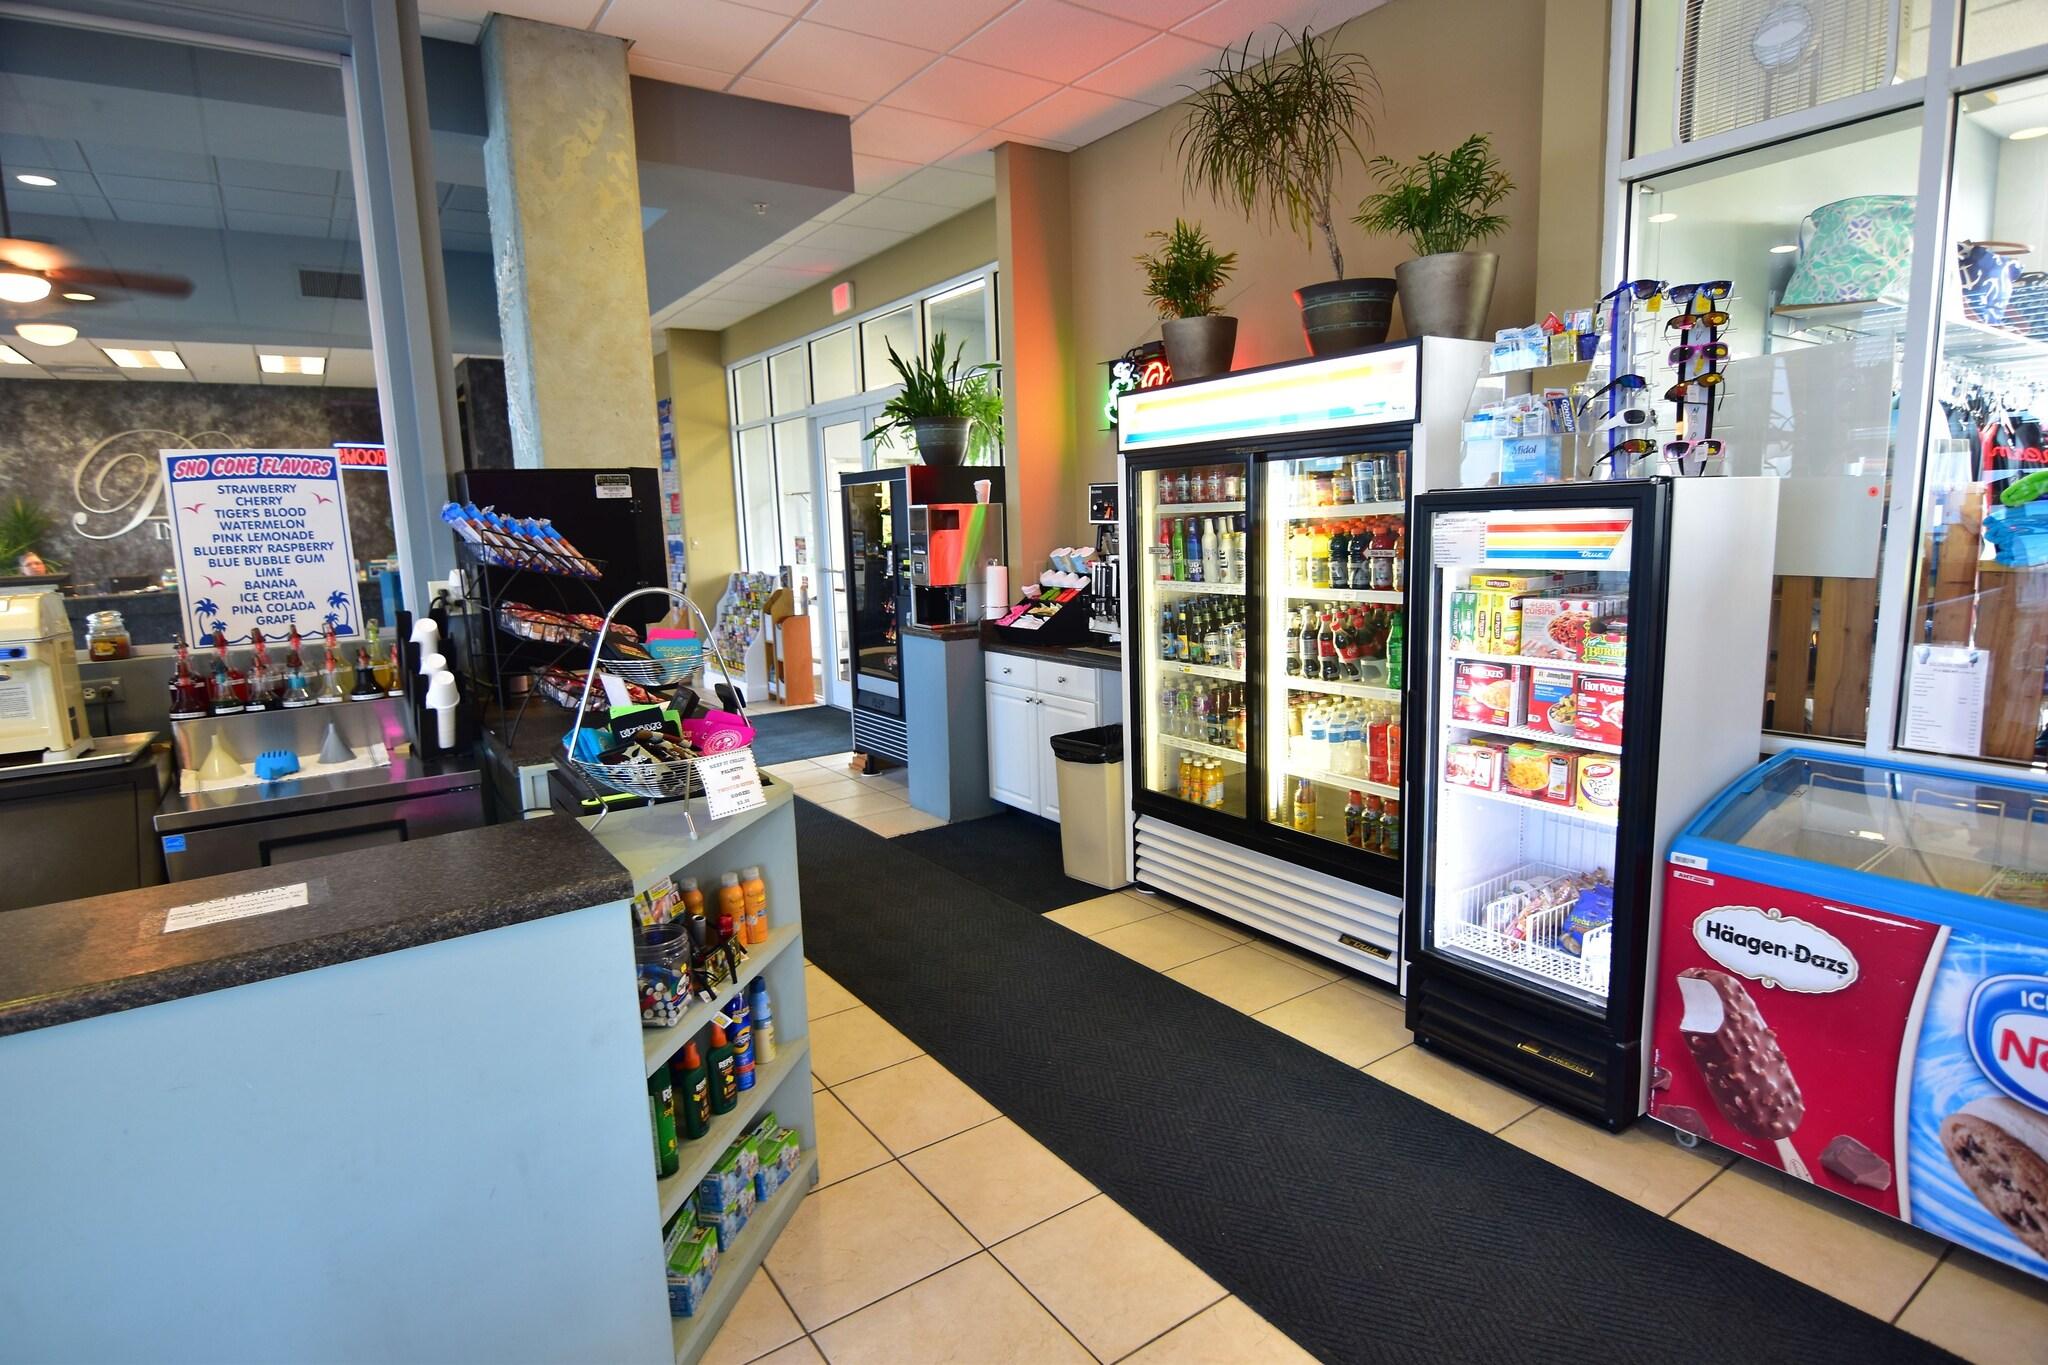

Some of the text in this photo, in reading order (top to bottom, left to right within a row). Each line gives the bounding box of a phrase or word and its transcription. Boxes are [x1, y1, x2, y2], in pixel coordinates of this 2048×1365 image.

[174, 456, 333, 479] SNO CONE FLAVORS
[217, 484, 297, 495] STRAWBERRY
[235, 496, 283, 506] CHERRY
[214, 507, 306, 519] TIGER'S BLOOD
[219, 519, 305, 531] WATERMELON
[212, 531, 315, 544] PINK LEMONADE
[194, 541, 335, 556] BLUEBERRY RASPBERRY
[208, 553, 325, 568] BLUE BUBBLE GUM
[255, 567, 284, 578] LIME
[244, 578, 297, 590] BANANA
[240, 590, 305, 603] ICE CREAM
[232, 602, 316, 616] PINA COLADA
[256, 614, 296, 626] GRAPE
[1706, 920, 1849, 976] Häagen-Dazs
[2020, 990, 2048, 1011] IC
